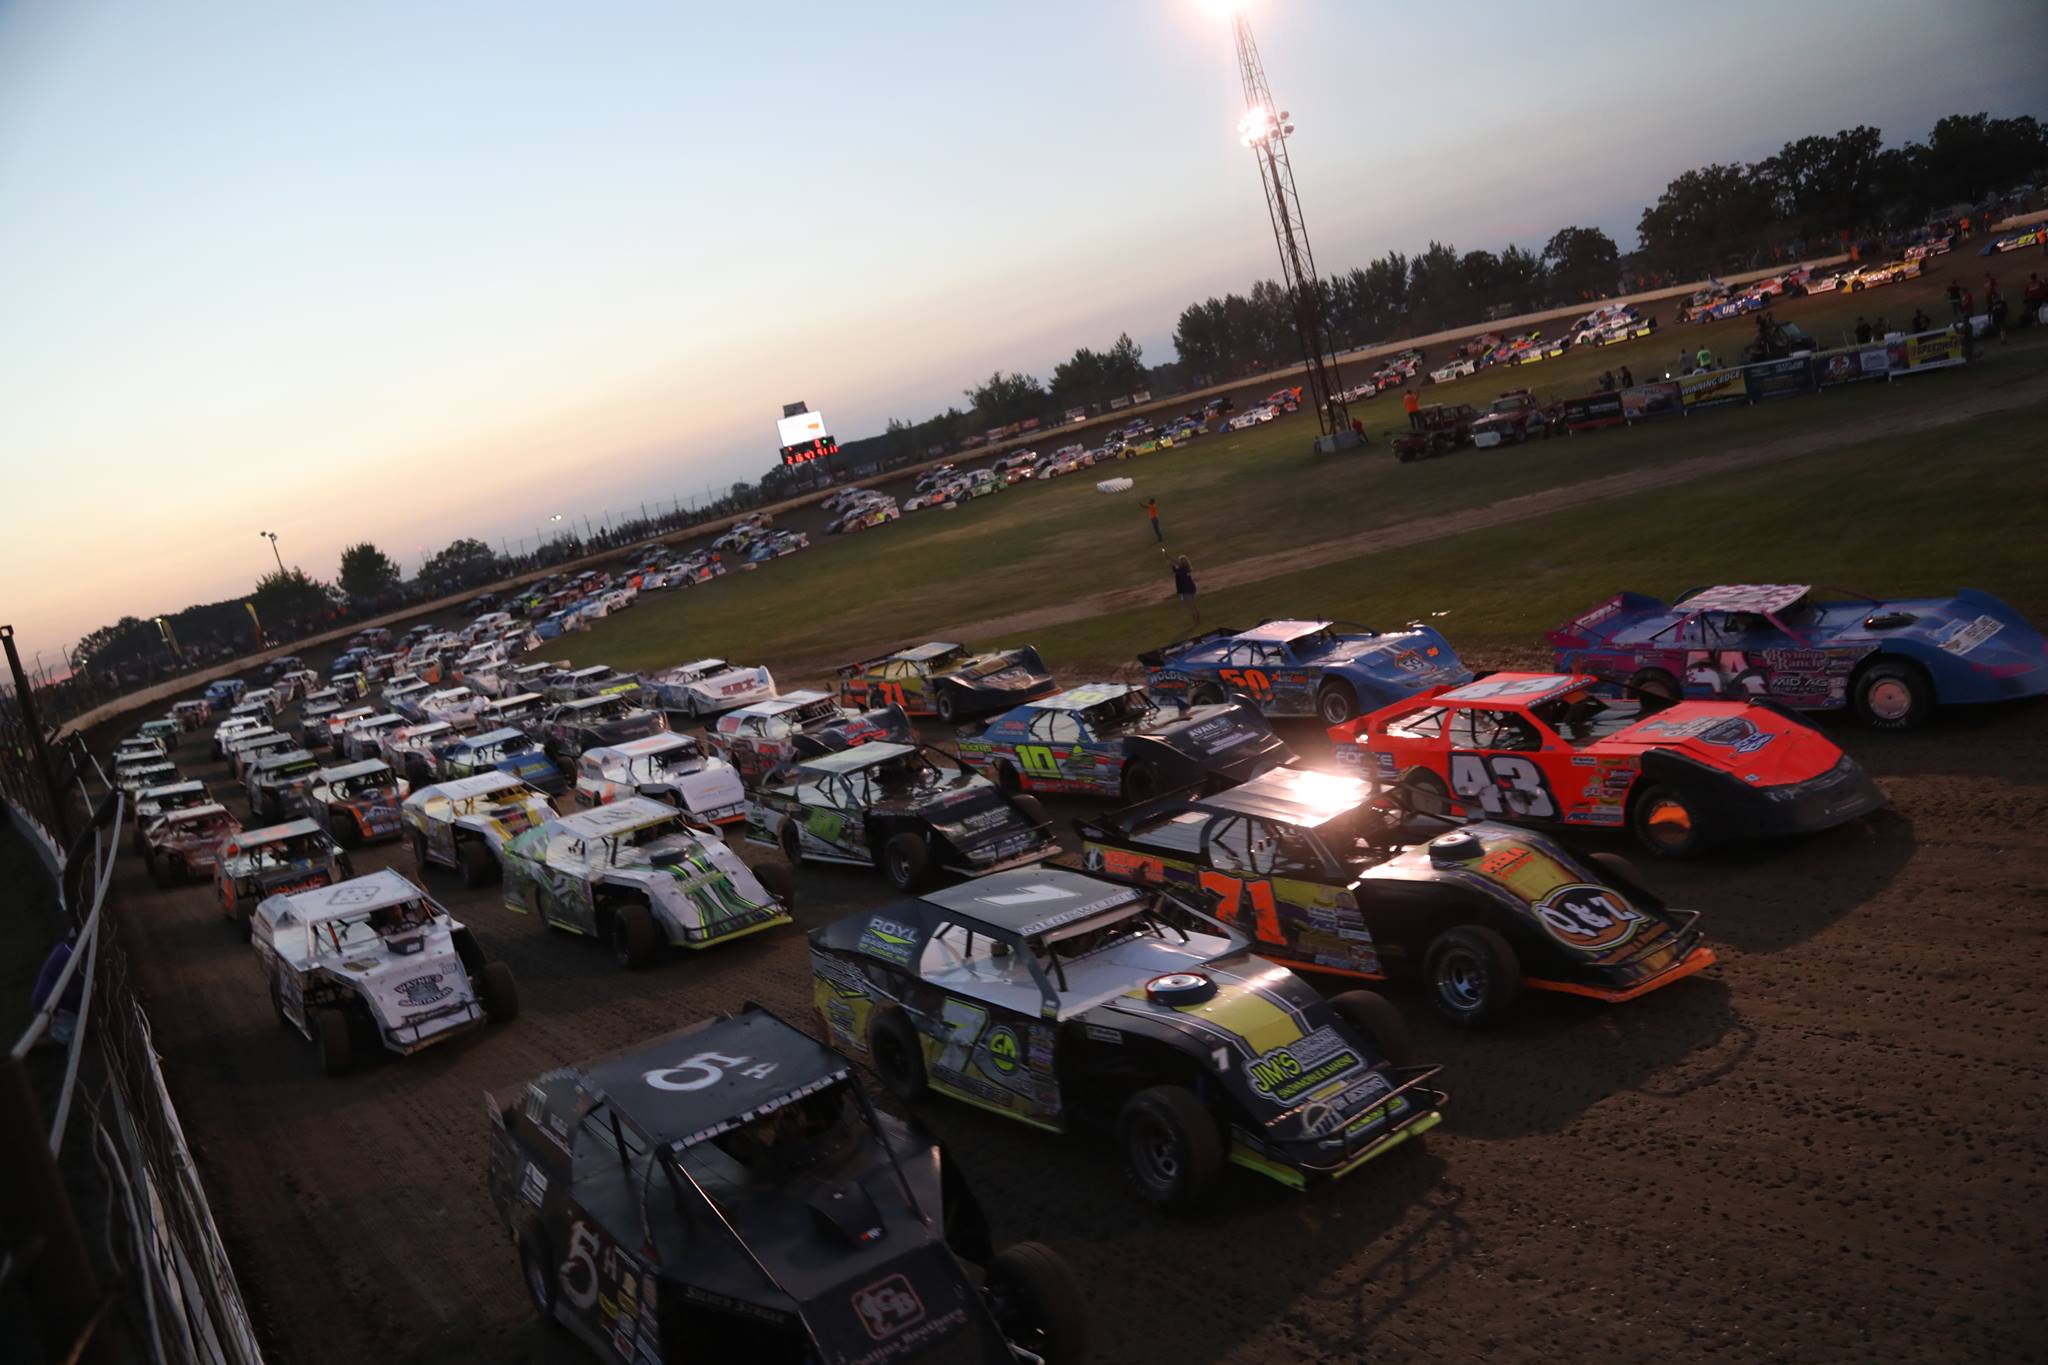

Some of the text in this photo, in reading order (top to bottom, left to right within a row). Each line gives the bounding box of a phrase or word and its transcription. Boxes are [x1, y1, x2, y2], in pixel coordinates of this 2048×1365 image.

[1015, 744, 1063, 779] 10
[1450, 754, 1554, 817] 43
[1199, 869, 1288, 945] 71
[1250, 1052, 1302, 1093] JIM'S
